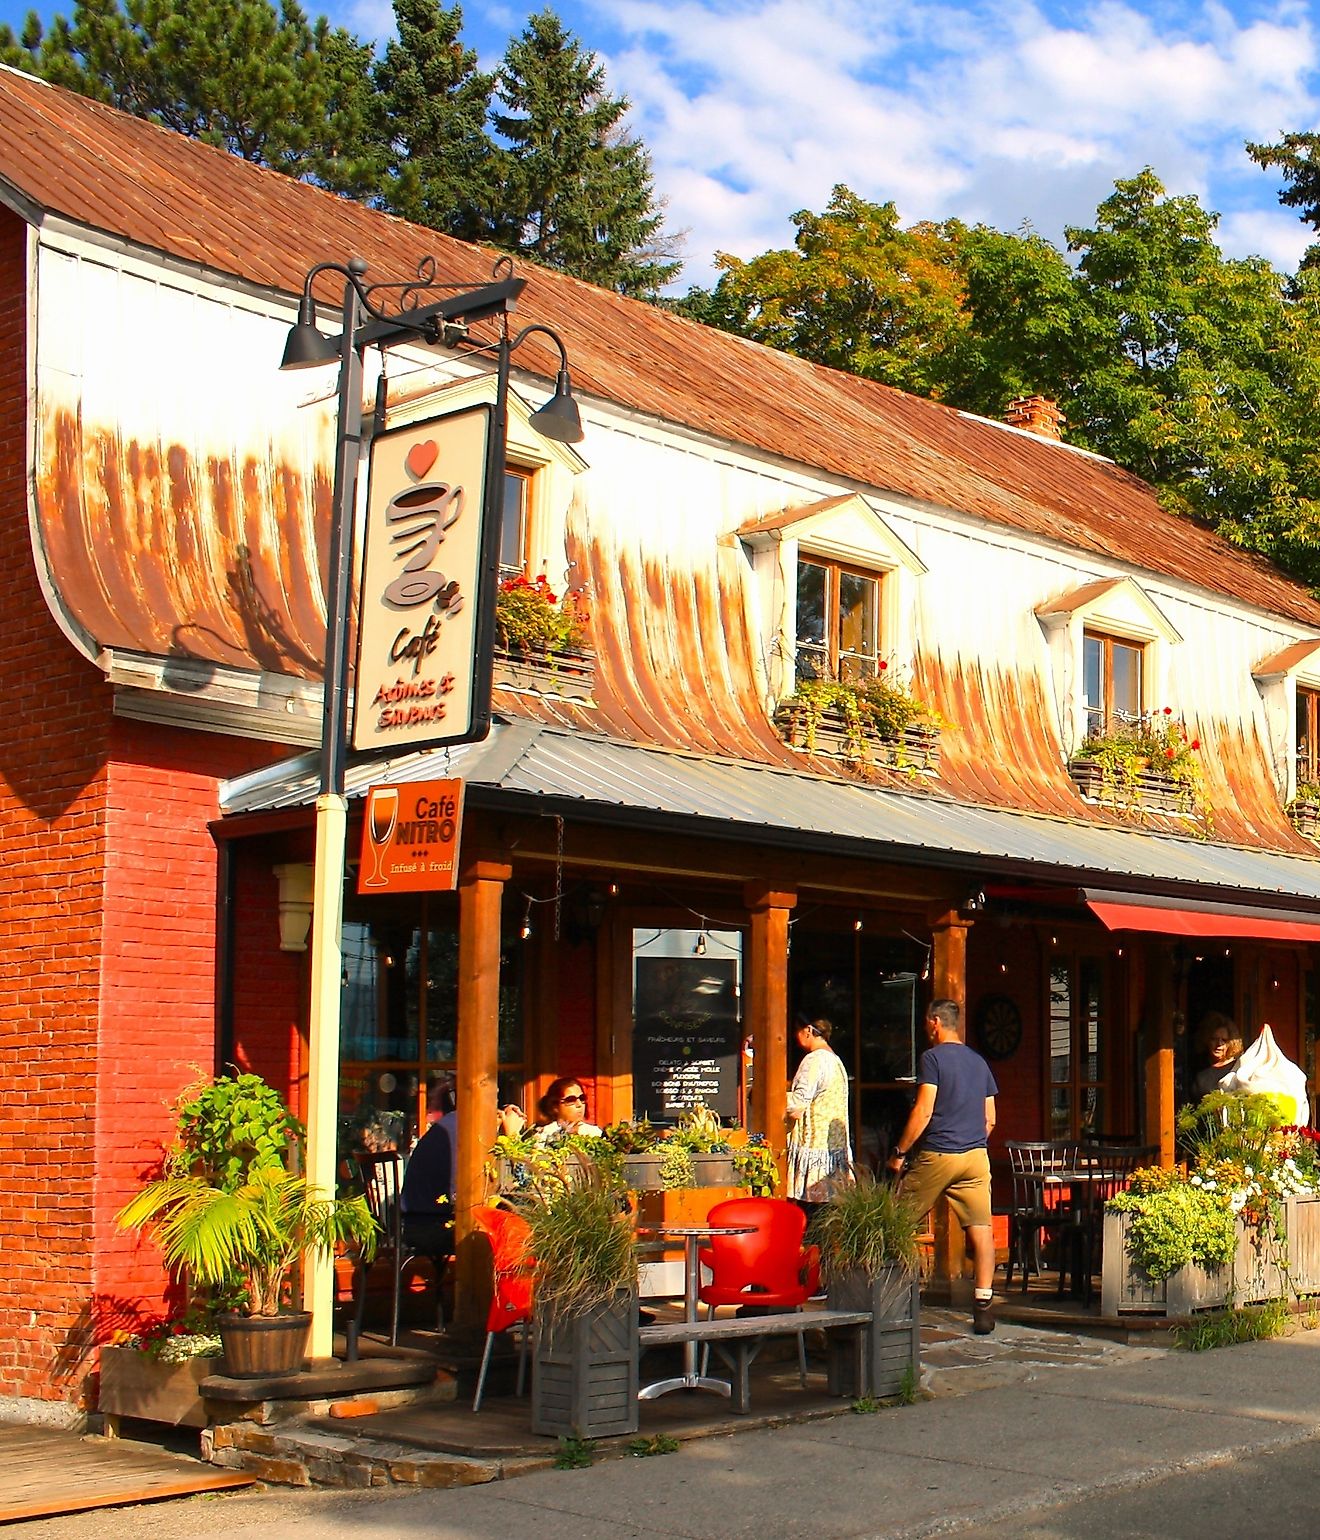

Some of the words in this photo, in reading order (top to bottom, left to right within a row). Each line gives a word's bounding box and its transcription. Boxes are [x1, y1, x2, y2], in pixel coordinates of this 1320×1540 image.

[391, 614, 442, 675] Café
[440, 671, 456, 696] et
[416, 795, 455, 819] Café
[396, 819, 455, 845] NITRO
[420, 862, 426, 872] à
[429, 860, 452, 872] froid
